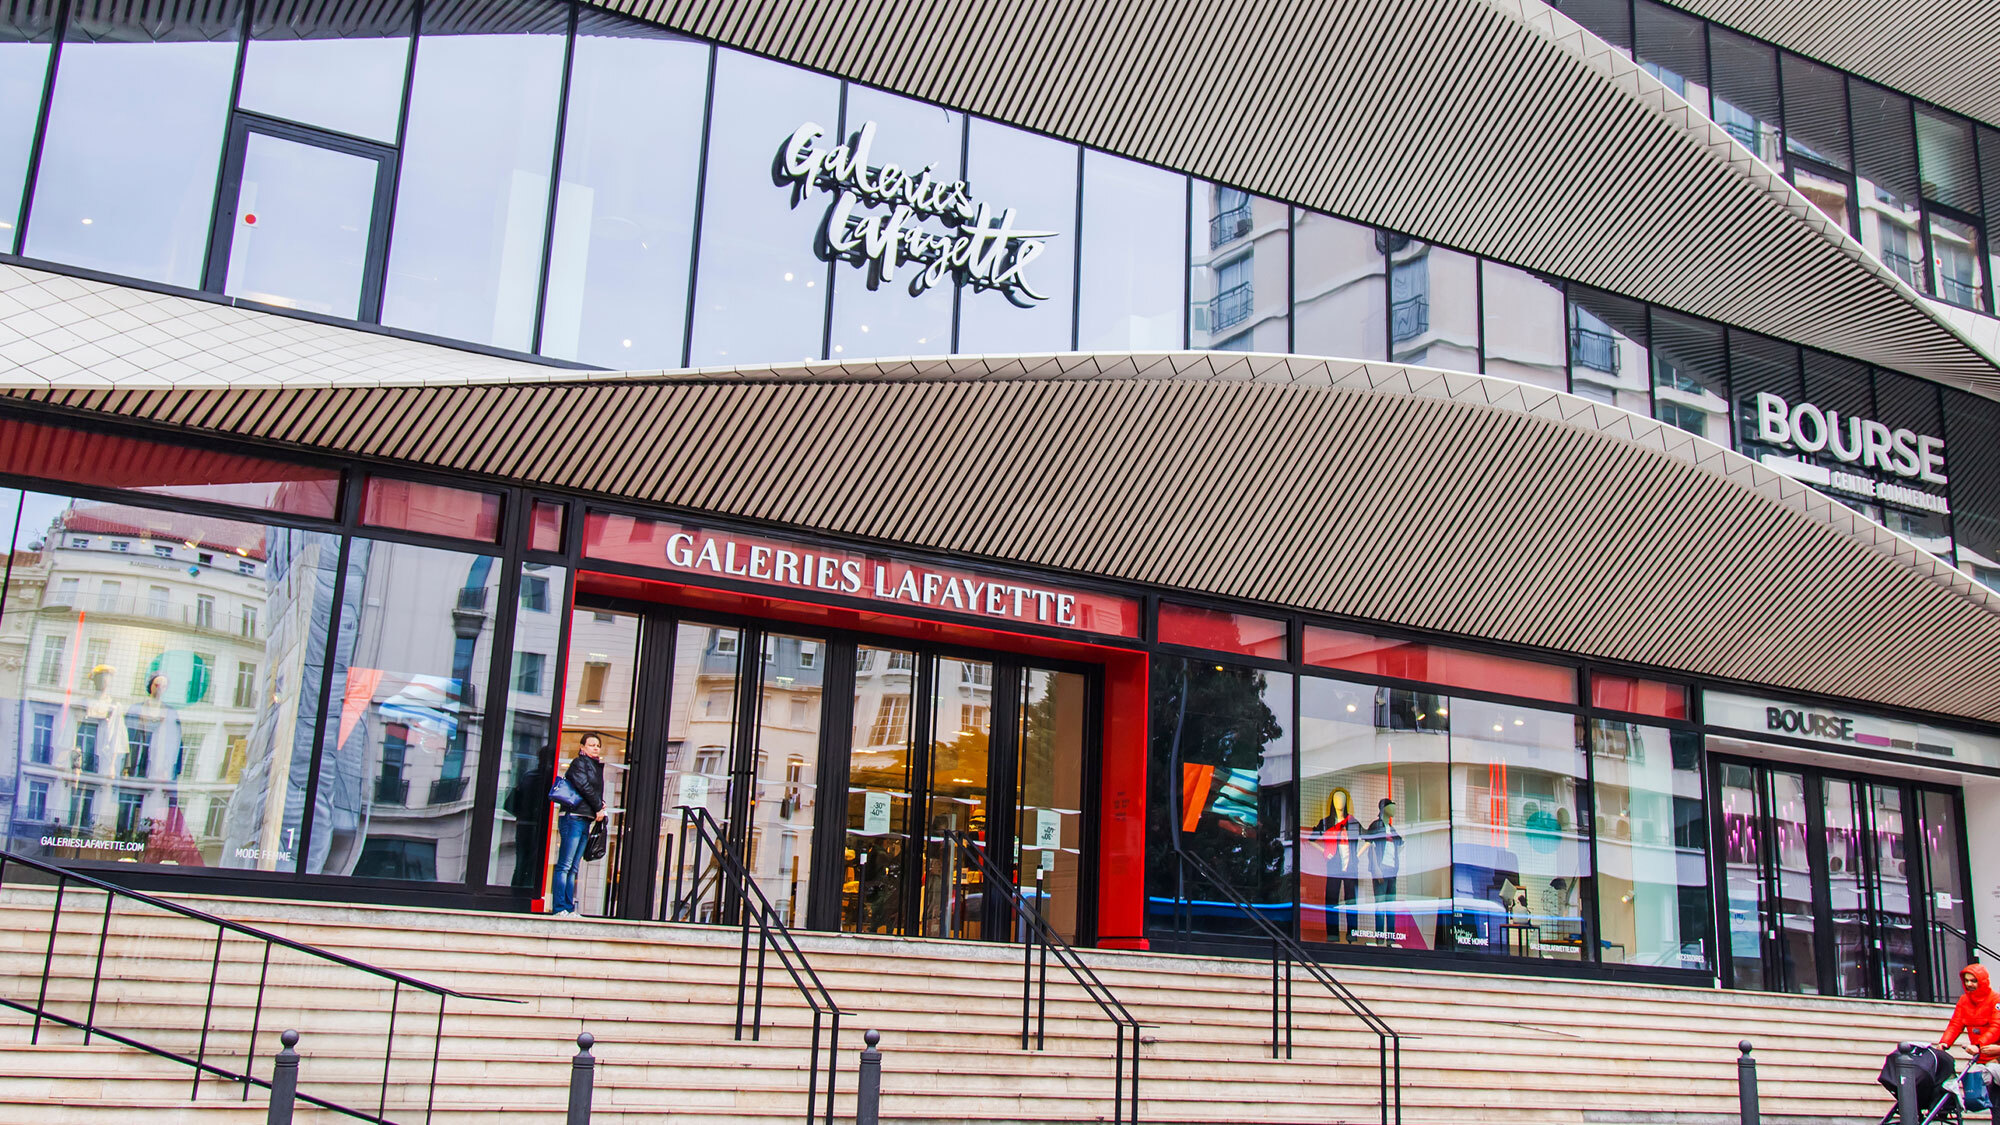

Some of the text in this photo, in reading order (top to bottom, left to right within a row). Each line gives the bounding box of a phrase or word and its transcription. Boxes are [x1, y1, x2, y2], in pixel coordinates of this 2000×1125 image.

[784, 120, 974, 219] Galeries
[828, 189, 1060, 300] Lafayette
[1757, 391, 1948, 485] BOURSE
[1830, 471, 1951, 515] CENTRE COMMERCIAL
[666, 532, 1076, 626] GALERIES LAFAYETTE
[1766, 706, 1855, 741] BOURSE
[40, 836, 145, 852] GALERIESLAFAYETTE.COM
[235, 847, 260, 859] MODE
[286, 827, 296, 850] 1
